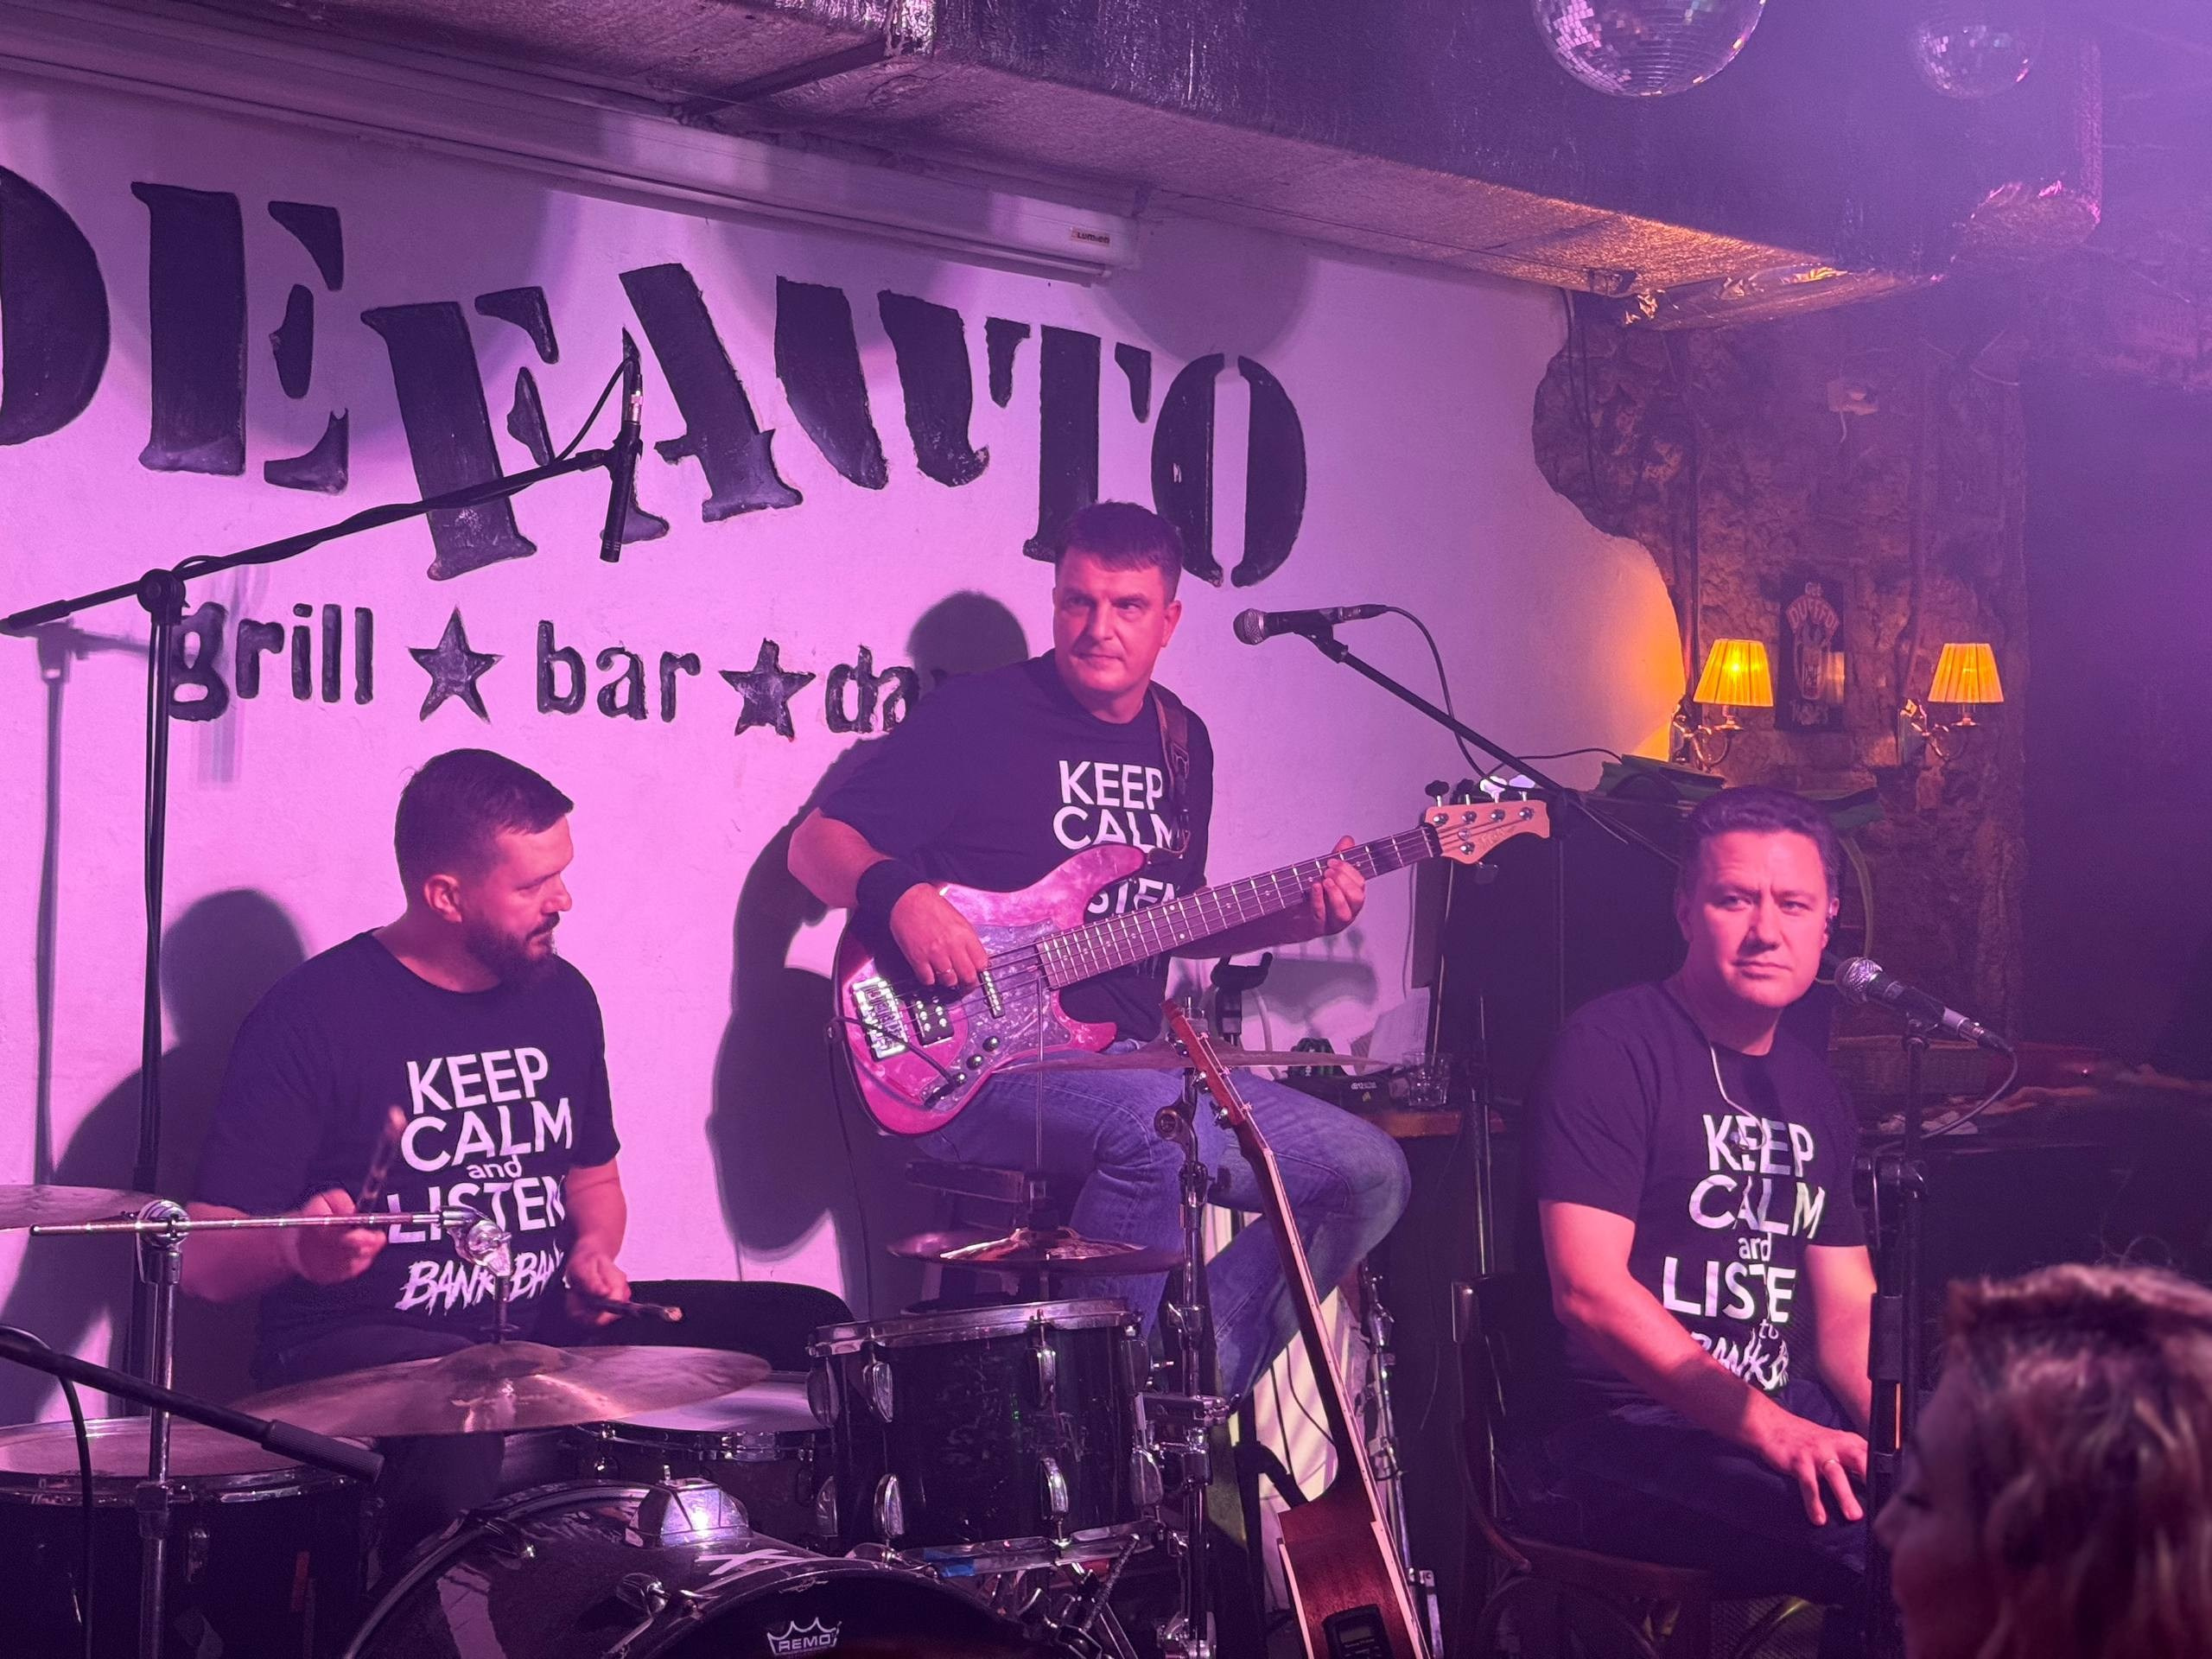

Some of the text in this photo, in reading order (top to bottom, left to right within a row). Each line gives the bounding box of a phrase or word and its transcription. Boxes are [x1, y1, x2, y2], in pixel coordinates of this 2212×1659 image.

[168, 601, 373, 722] grill
[537, 619, 701, 723] bar
[1058, 760, 1163, 810] KEEP
[406, 1046, 549, 1115] KEEP
[400, 1097, 572, 1172] CALM
[1703, 1115, 1814, 1178] KEEP
[467, 1154, 523, 1180] and
[1689, 1174, 1825, 1239] CALM
[1758, 1319, 1779, 1339] to
[779, 1633, 831, 1652] REMO
